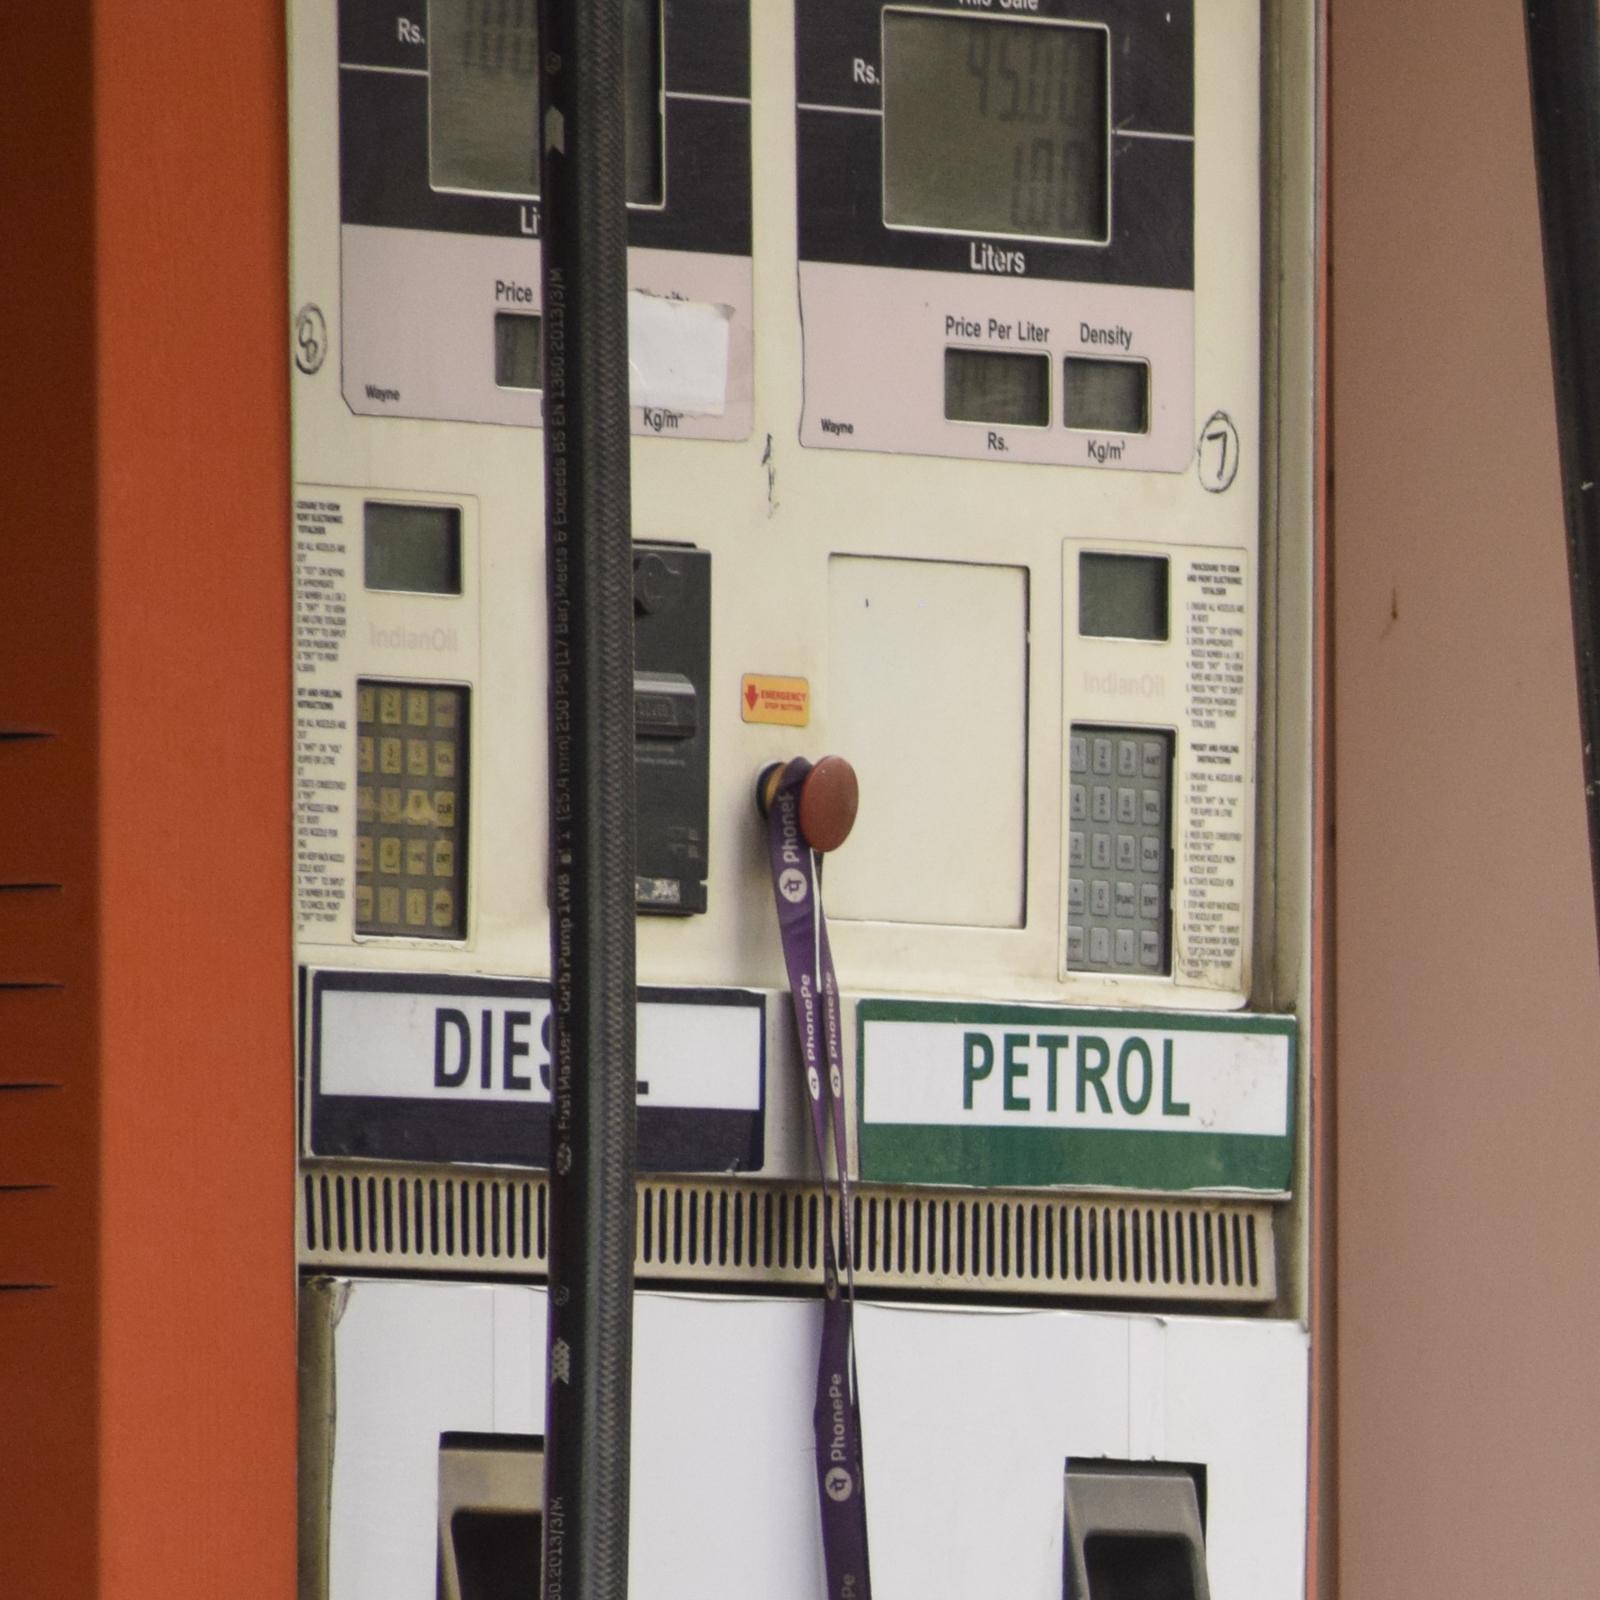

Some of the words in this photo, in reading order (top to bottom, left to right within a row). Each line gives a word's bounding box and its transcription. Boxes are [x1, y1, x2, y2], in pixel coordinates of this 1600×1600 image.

[398, 18, 426, 45] Rs.
[853, 58, 880, 85] Rs.
[970, 245, 1026, 275] Liters
[494, 280, 533, 303] Price
[945, 316, 981, 339] Price
[988, 318, 1012, 341] Per
[1017, 320, 1050, 344] Liter
[1079, 323, 1133, 352] Density
[365, 383, 401, 402] Wayne
[821, 418, 854, 436] Wayne
[987, 432, 1010, 453] Rs.
[553, 457, 568, 526] Exceeds
[800, 973, 816, 1061] PhonePe
[823, 970, 839, 1059] PhonePe
[963, 1032, 1192, 1118] PETROL
[828, 1372, 848, 1463] PhonePe
